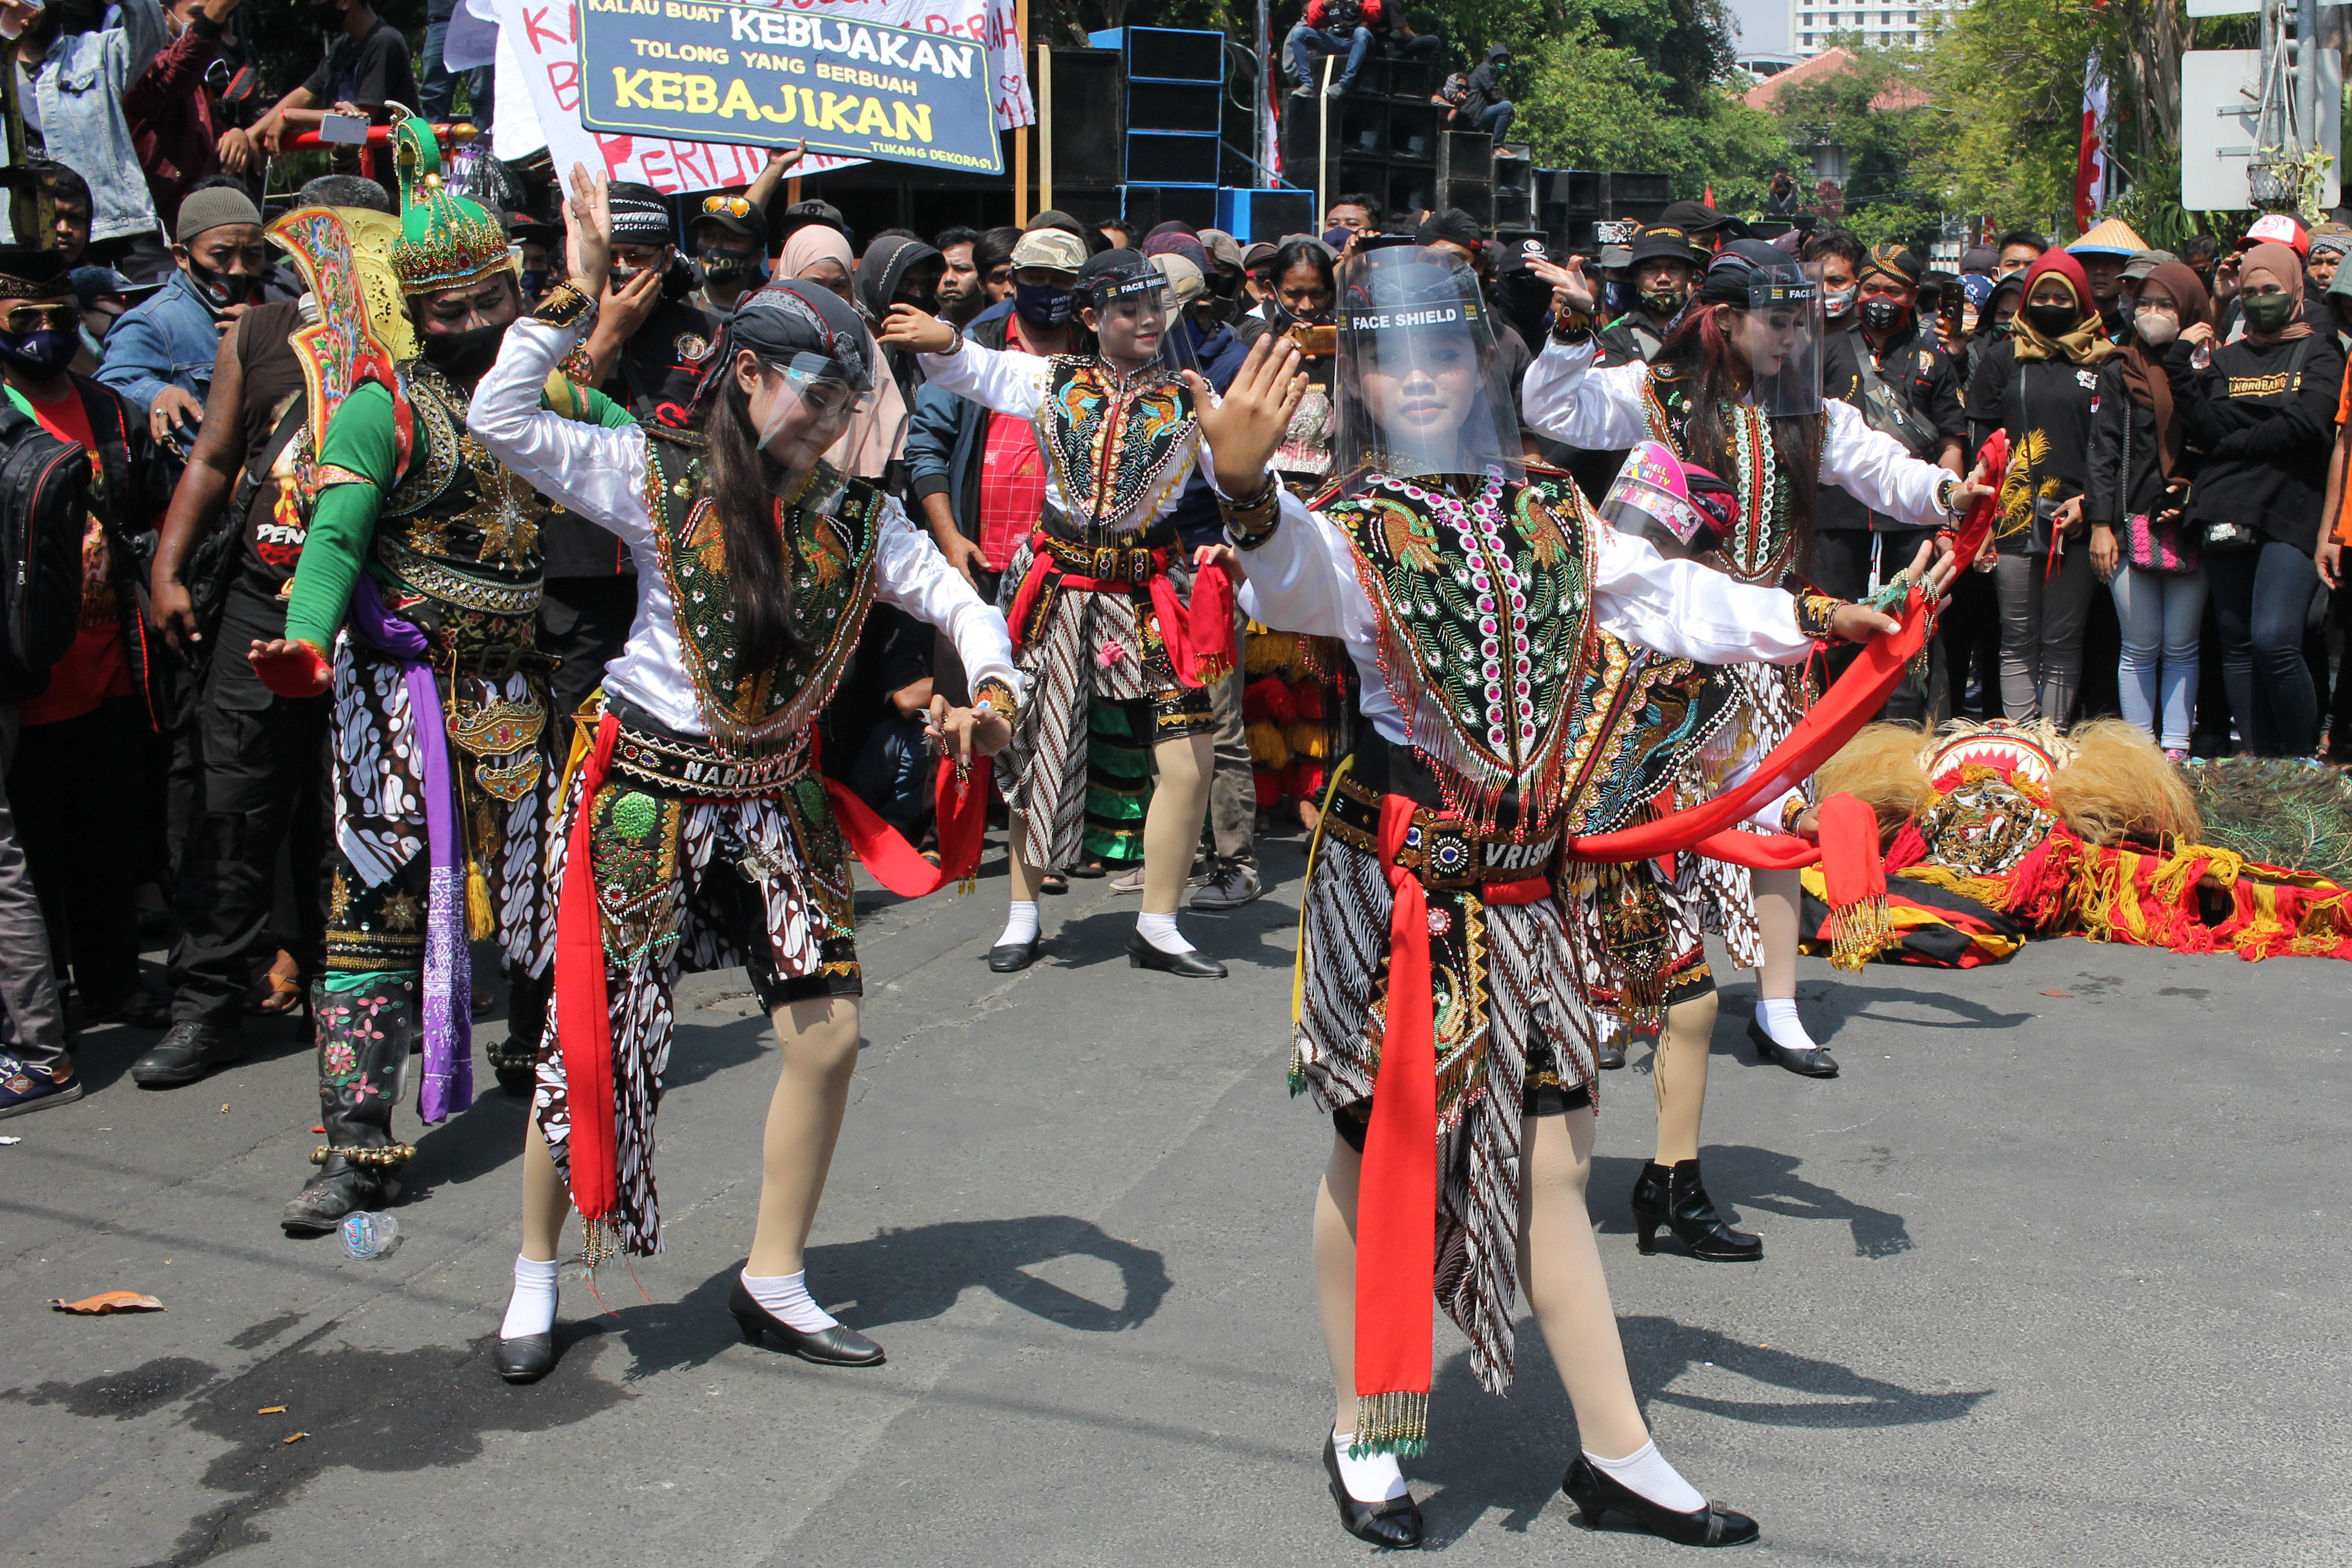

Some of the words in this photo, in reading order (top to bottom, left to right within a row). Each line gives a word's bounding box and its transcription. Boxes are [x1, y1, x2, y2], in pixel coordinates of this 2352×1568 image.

[589, 0, 660, 15] KALAU
[666, 2, 725, 23] BUAT
[729, 8, 974, 79] KEBIJAKAN
[630, 38, 729, 65] TOLONG
[740, 51, 806, 74] YANG
[816, 63, 918, 96] BERBUAH
[612, 66, 933, 142] KEBAJIKAN
[870, 141, 927, 159] TUKANG
[929, 149, 992, 170] DEKORASI
[1121, 281, 1145, 293] FACE
[1789, 289, 1810, 299] FACE
[1353, 314, 1390, 330] FACE
[1395, 308, 1456, 327] SHIELD
[1642, 469, 1671, 486] KITTY
[683, 755, 799, 787] NABILLAH
[348, 1223, 359, 1245] Club
